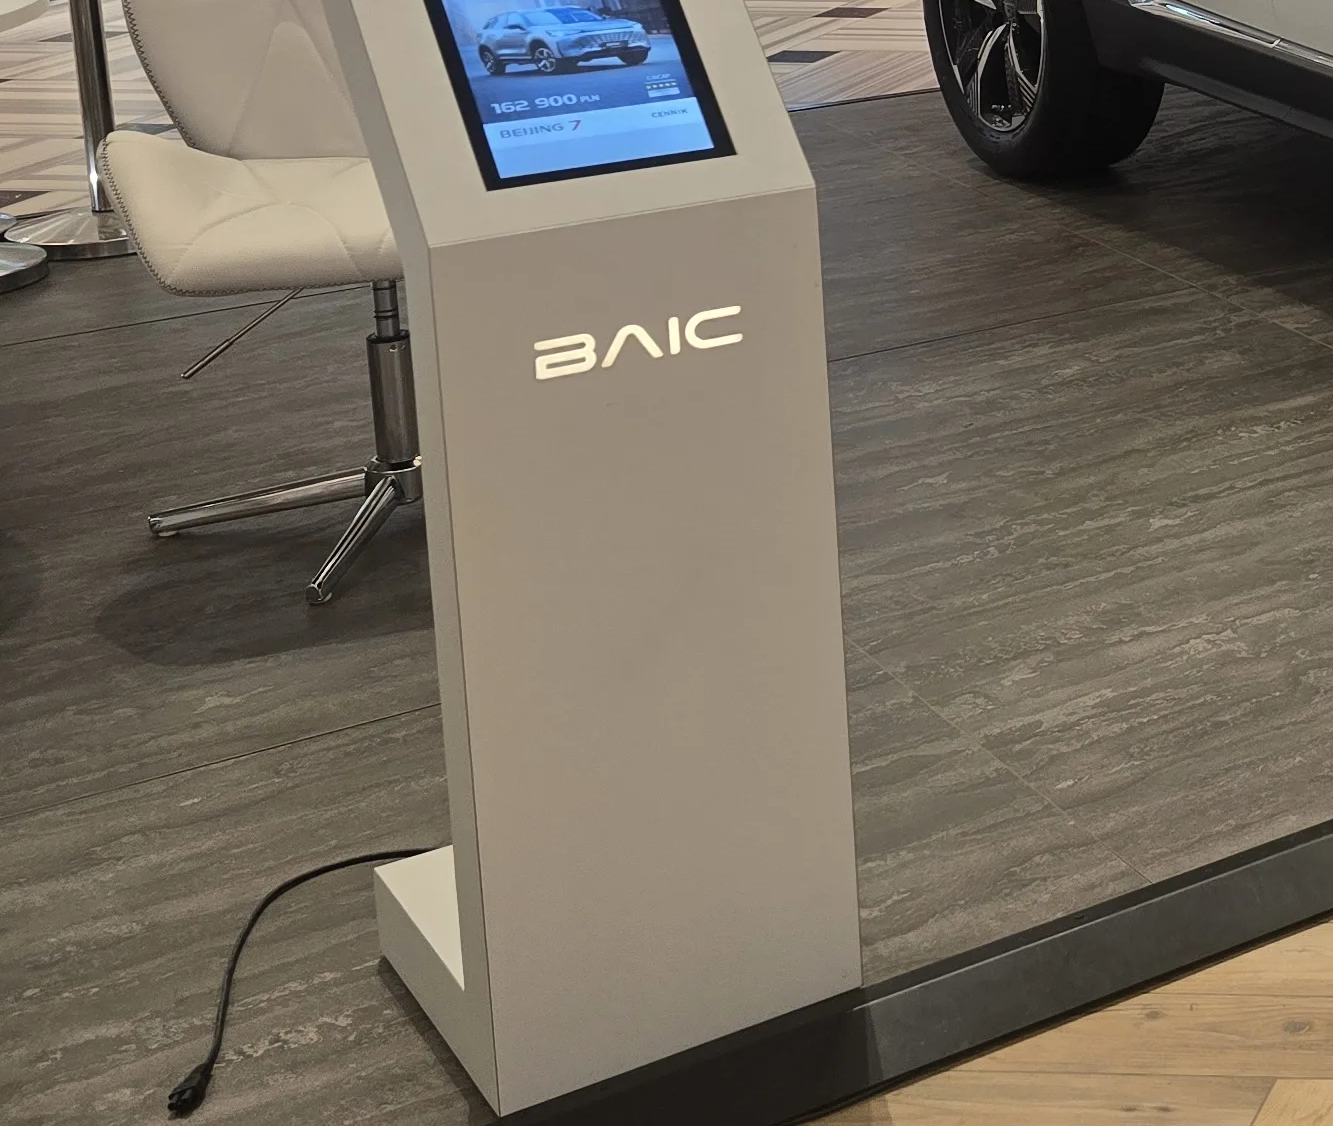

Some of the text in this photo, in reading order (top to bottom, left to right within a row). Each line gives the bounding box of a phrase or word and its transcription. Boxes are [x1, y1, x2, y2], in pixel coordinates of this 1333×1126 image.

[490, 93, 600, 114] 162 900 PLN
[651, 108, 688, 118] CENNIK
[500, 120, 582, 139] BEIJING 7
[534, 305, 743, 380] BAIC
